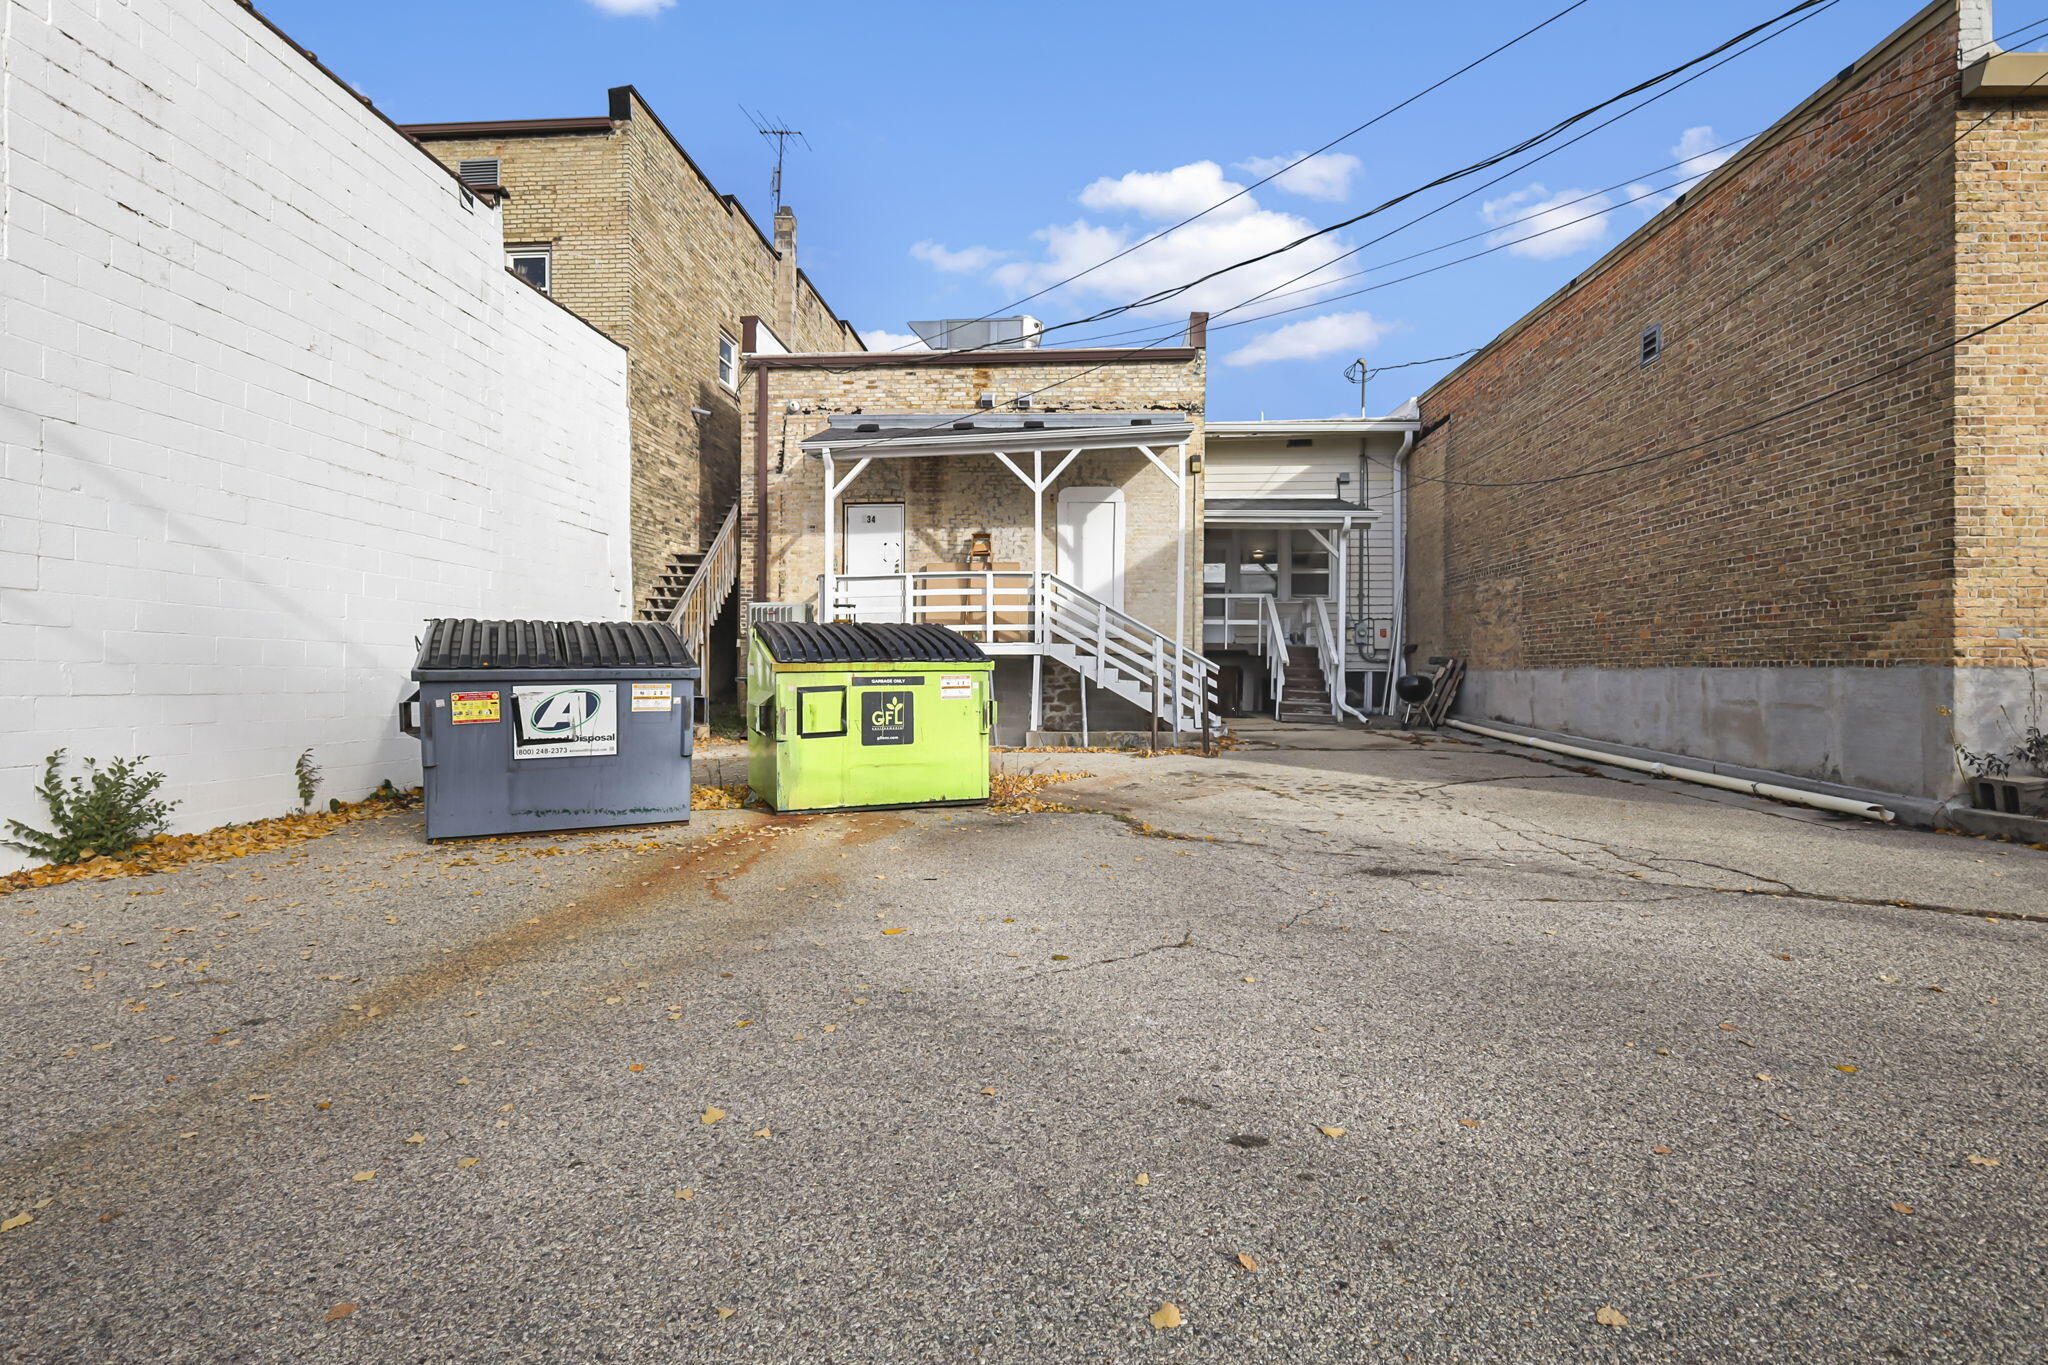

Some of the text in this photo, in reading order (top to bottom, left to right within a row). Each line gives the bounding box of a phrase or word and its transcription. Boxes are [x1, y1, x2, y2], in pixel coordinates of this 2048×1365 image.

[866, 515, 876, 524] 34
[872, 702, 904, 726] GFL
[574, 733, 615, 743] Disposal
[516, 748, 534, 756] (800)
[536, 747, 568, 755] 248-2373
